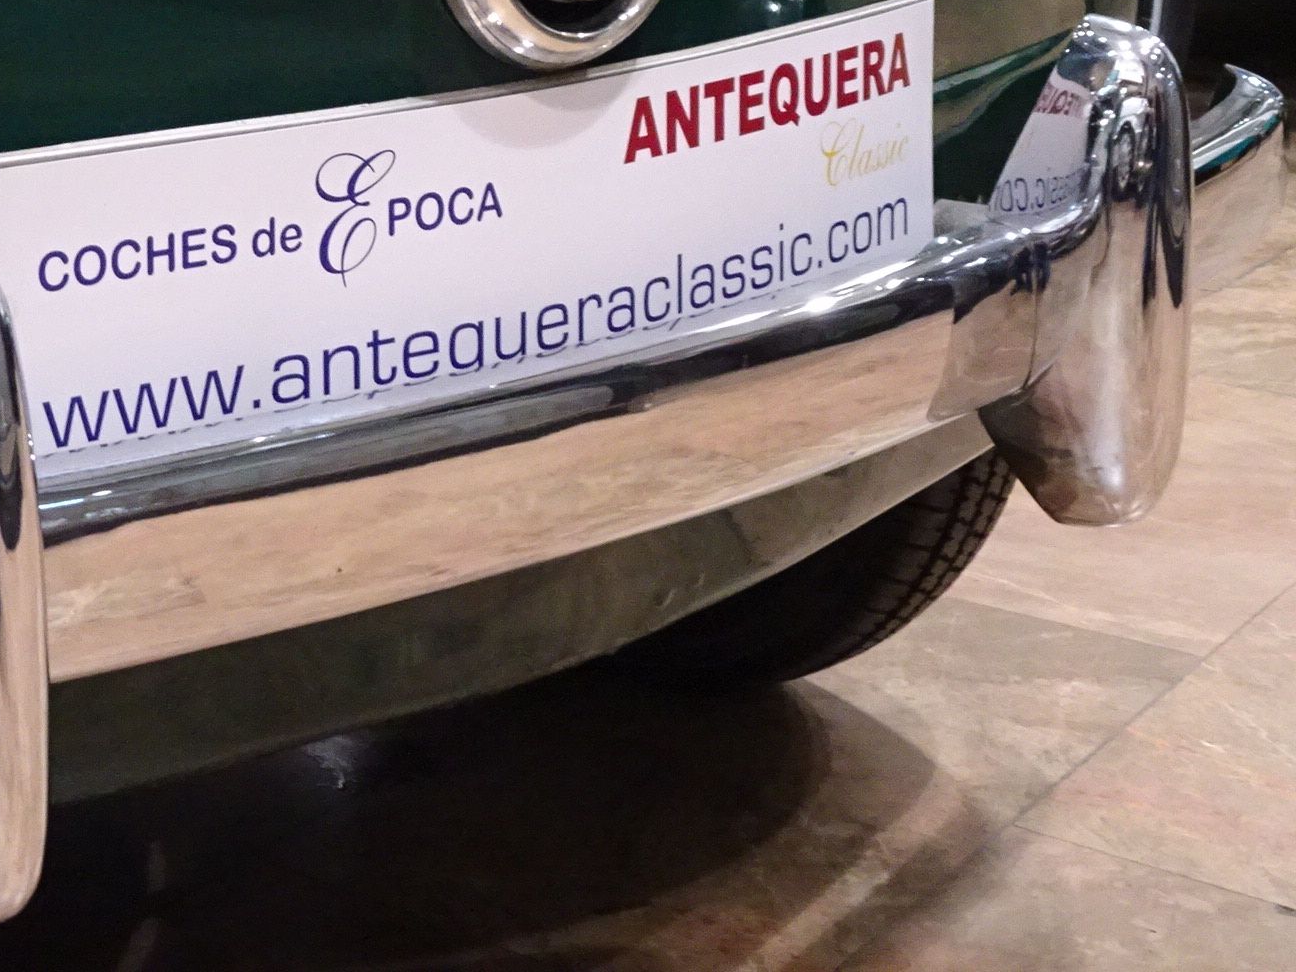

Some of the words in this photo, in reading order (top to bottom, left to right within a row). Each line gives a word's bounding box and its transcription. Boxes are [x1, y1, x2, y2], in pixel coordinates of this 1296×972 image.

[623, 32, 911, 164] ANTEQUERA
[820, 118, 910, 187] Classic
[38, 223, 238, 292] COCHES
[251, 216, 303, 258] de
[42, 196, 909, 449] www.antequeraclassic.com
